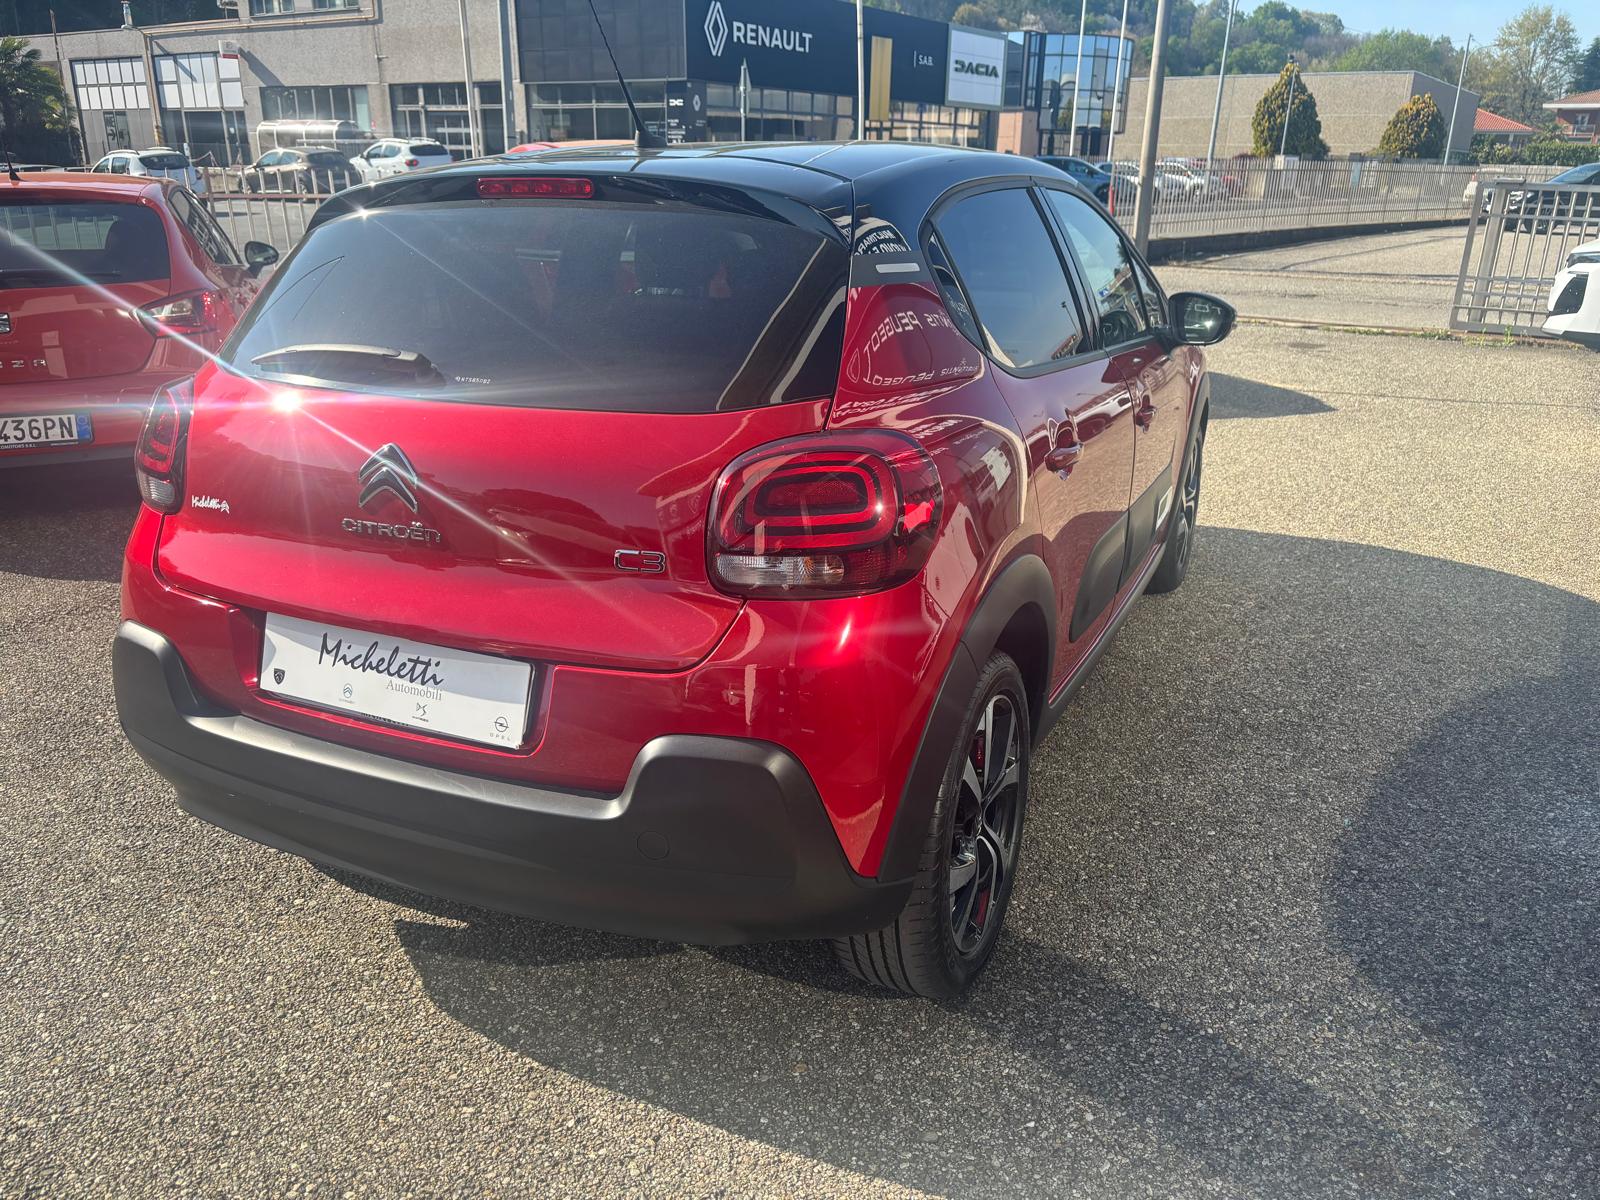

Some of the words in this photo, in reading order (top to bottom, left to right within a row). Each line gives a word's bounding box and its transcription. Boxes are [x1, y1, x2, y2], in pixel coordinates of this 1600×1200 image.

[732, 20, 813, 54] RENAULT
[954, 59, 1000, 78] DACIA
[613, 549, 666, 573] C3
[318, 632, 444, 686] Micheletti
[385, 679, 442, 701] Automobili
